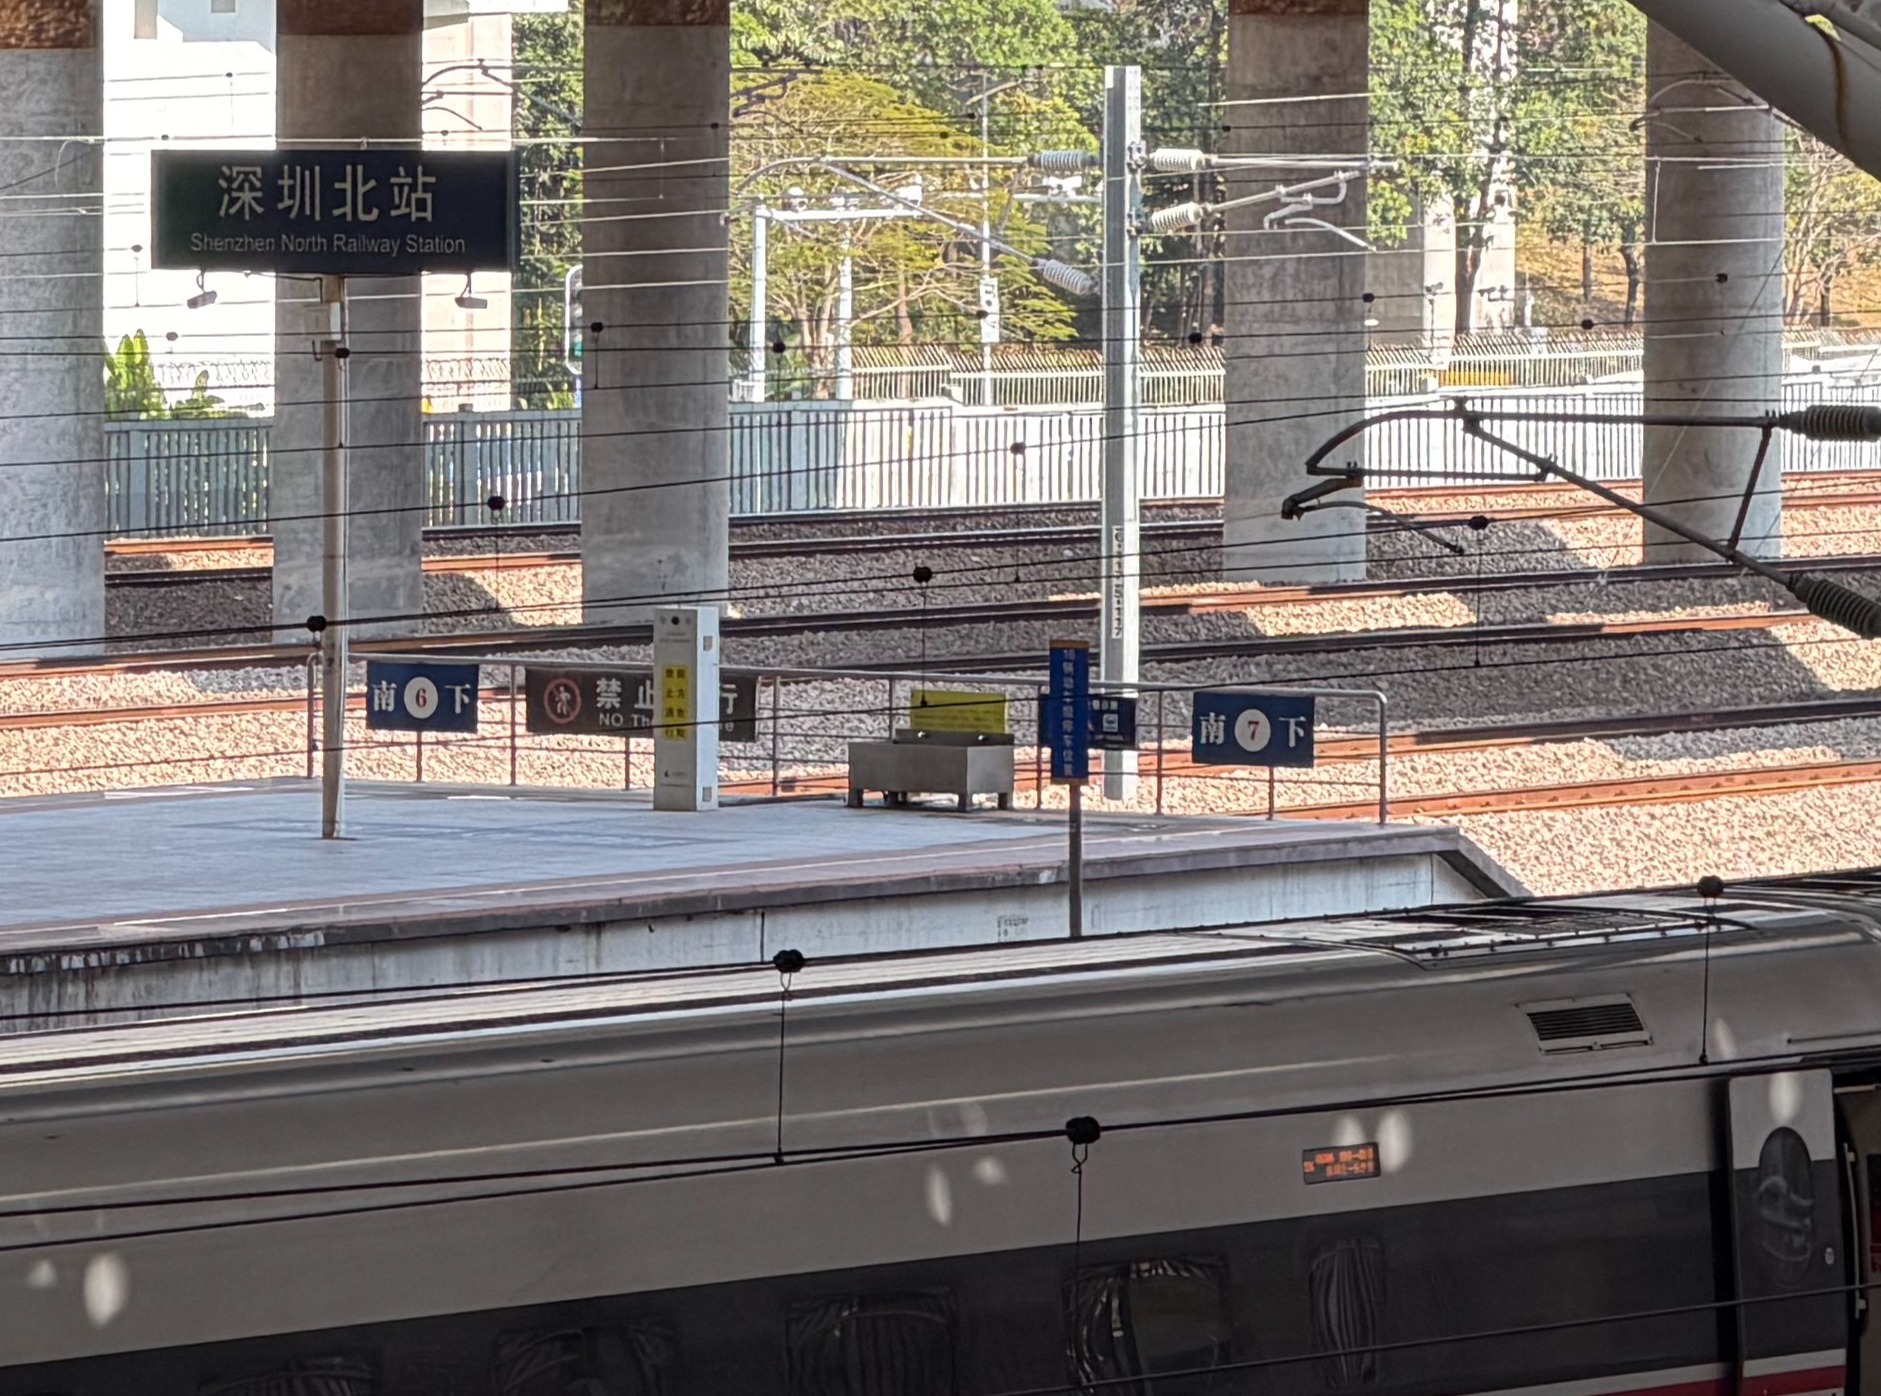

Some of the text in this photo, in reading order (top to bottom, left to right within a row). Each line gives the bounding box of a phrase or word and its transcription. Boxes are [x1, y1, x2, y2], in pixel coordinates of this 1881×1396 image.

[218, 165, 436, 221] 深圳北站
[190, 232, 465, 257] Shenzhen North Railway Station
[372, 680, 470, 714] 南 6 下
[599, 713, 623, 727] NO
[1199, 711, 1305, 748] 南 7 下
